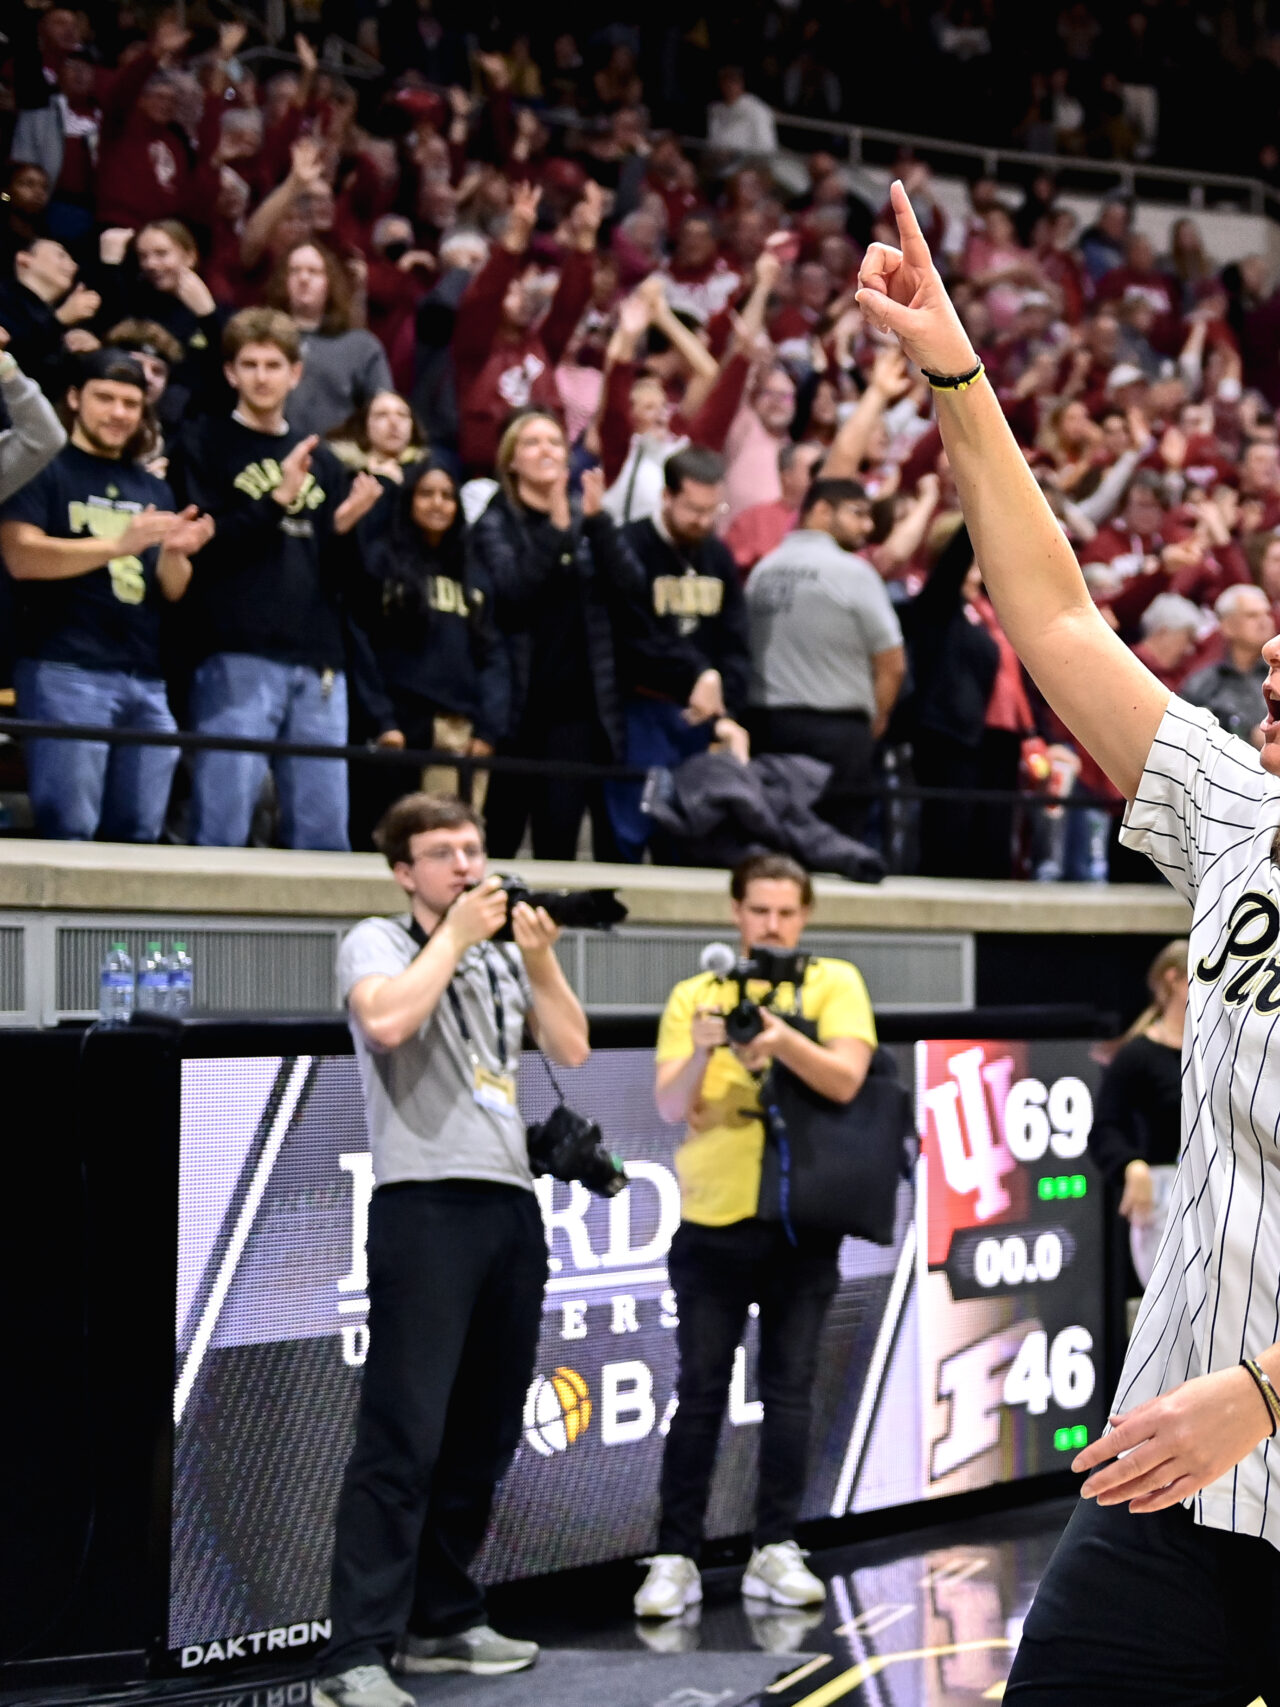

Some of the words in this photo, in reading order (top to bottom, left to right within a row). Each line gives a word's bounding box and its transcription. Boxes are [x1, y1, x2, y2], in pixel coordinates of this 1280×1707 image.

[1004, 1076, 1094, 1161] 69
[973, 1232, 1063, 1288] 00.0
[1003, 1324, 1095, 1414] 46
[180, 1618, 333, 1670] DAKTRON
